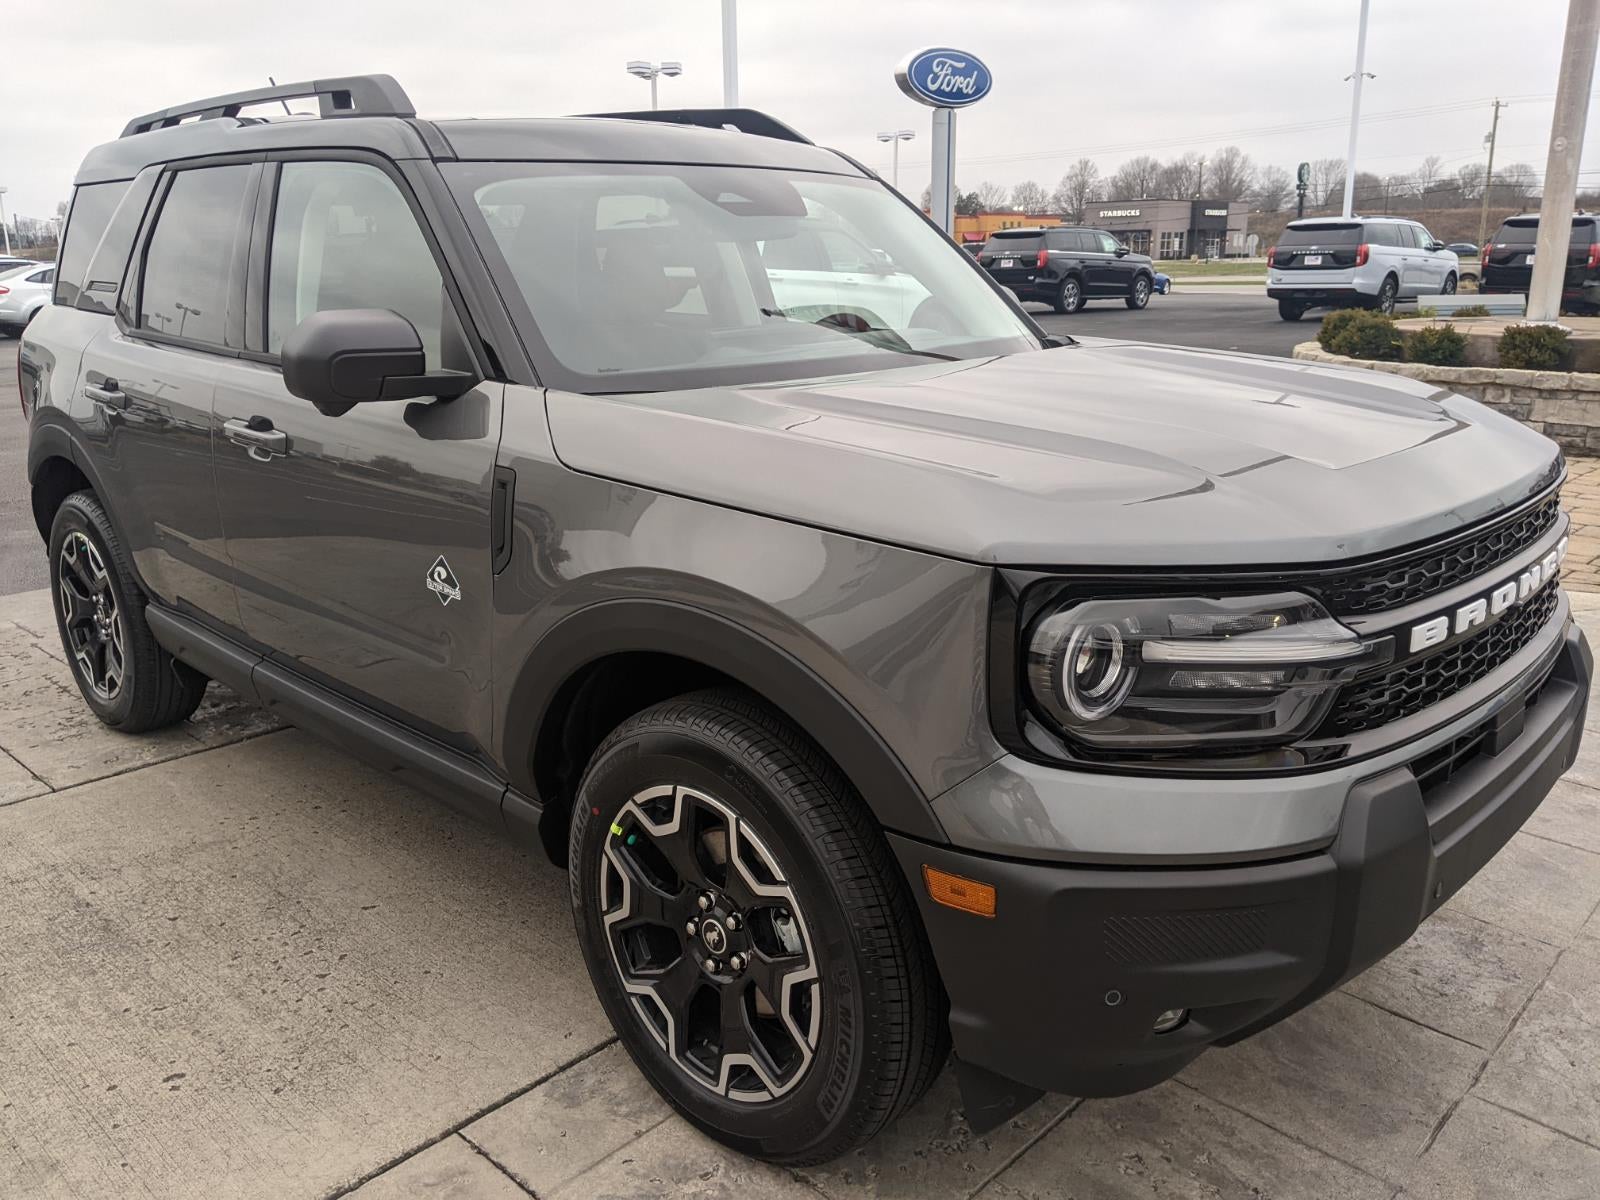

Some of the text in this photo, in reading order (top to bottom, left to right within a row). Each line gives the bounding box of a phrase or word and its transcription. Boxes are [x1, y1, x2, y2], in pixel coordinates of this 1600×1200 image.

[927, 57, 977, 95] Ford
[1099, 209, 1140, 218] STARBUCKS
[821, 1006, 852, 1115] MICHELIN
